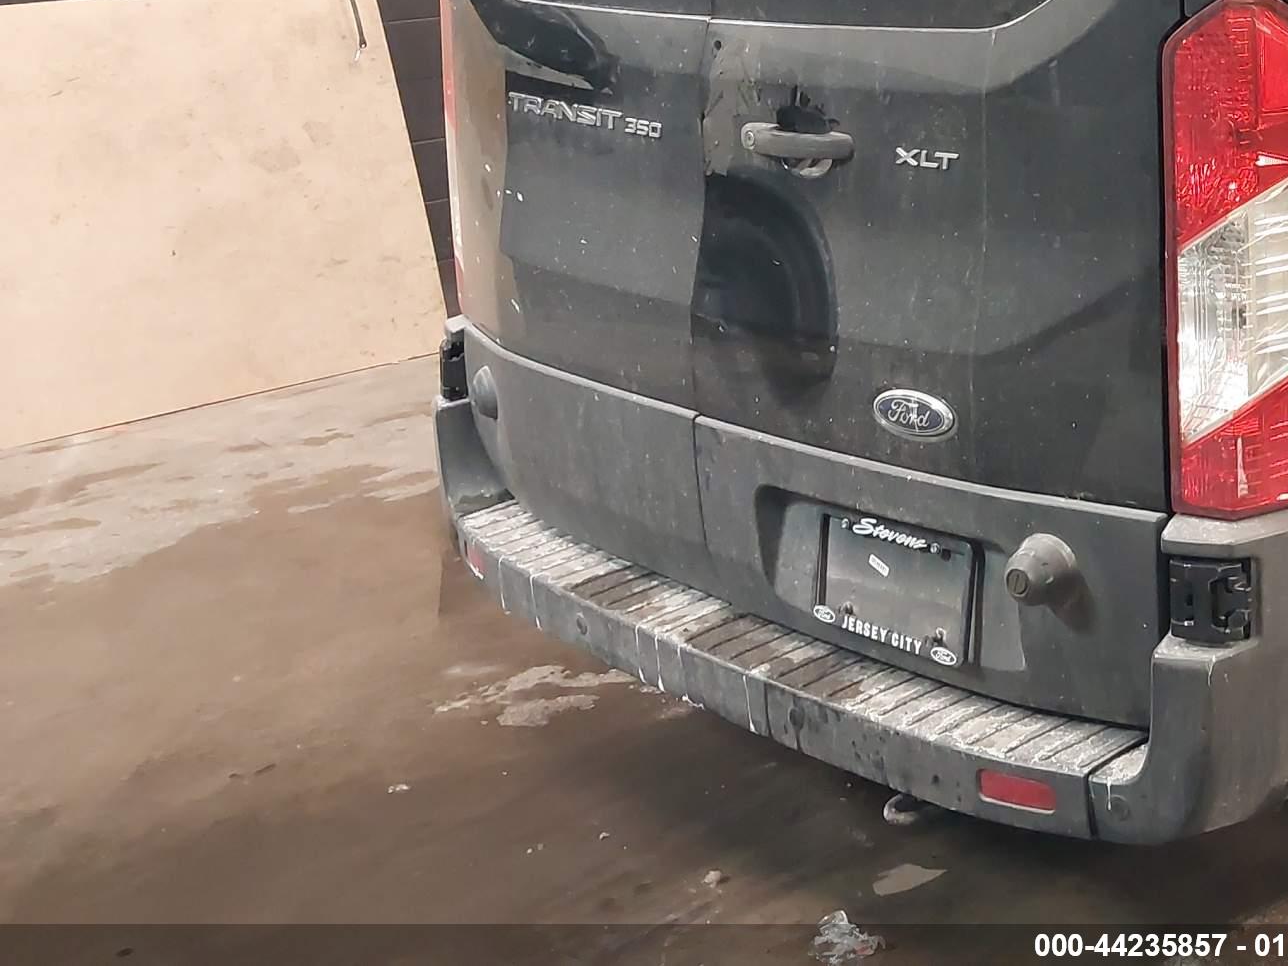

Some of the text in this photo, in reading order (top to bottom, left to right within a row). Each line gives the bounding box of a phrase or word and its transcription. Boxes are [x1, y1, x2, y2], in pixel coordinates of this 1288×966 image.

[508, 91, 663, 138] TRANSIT 350
[895, 147, 960, 170] XLT
[852, 517, 928, 549] Stevens
[841, 615, 922, 655] JERSEY CITY
